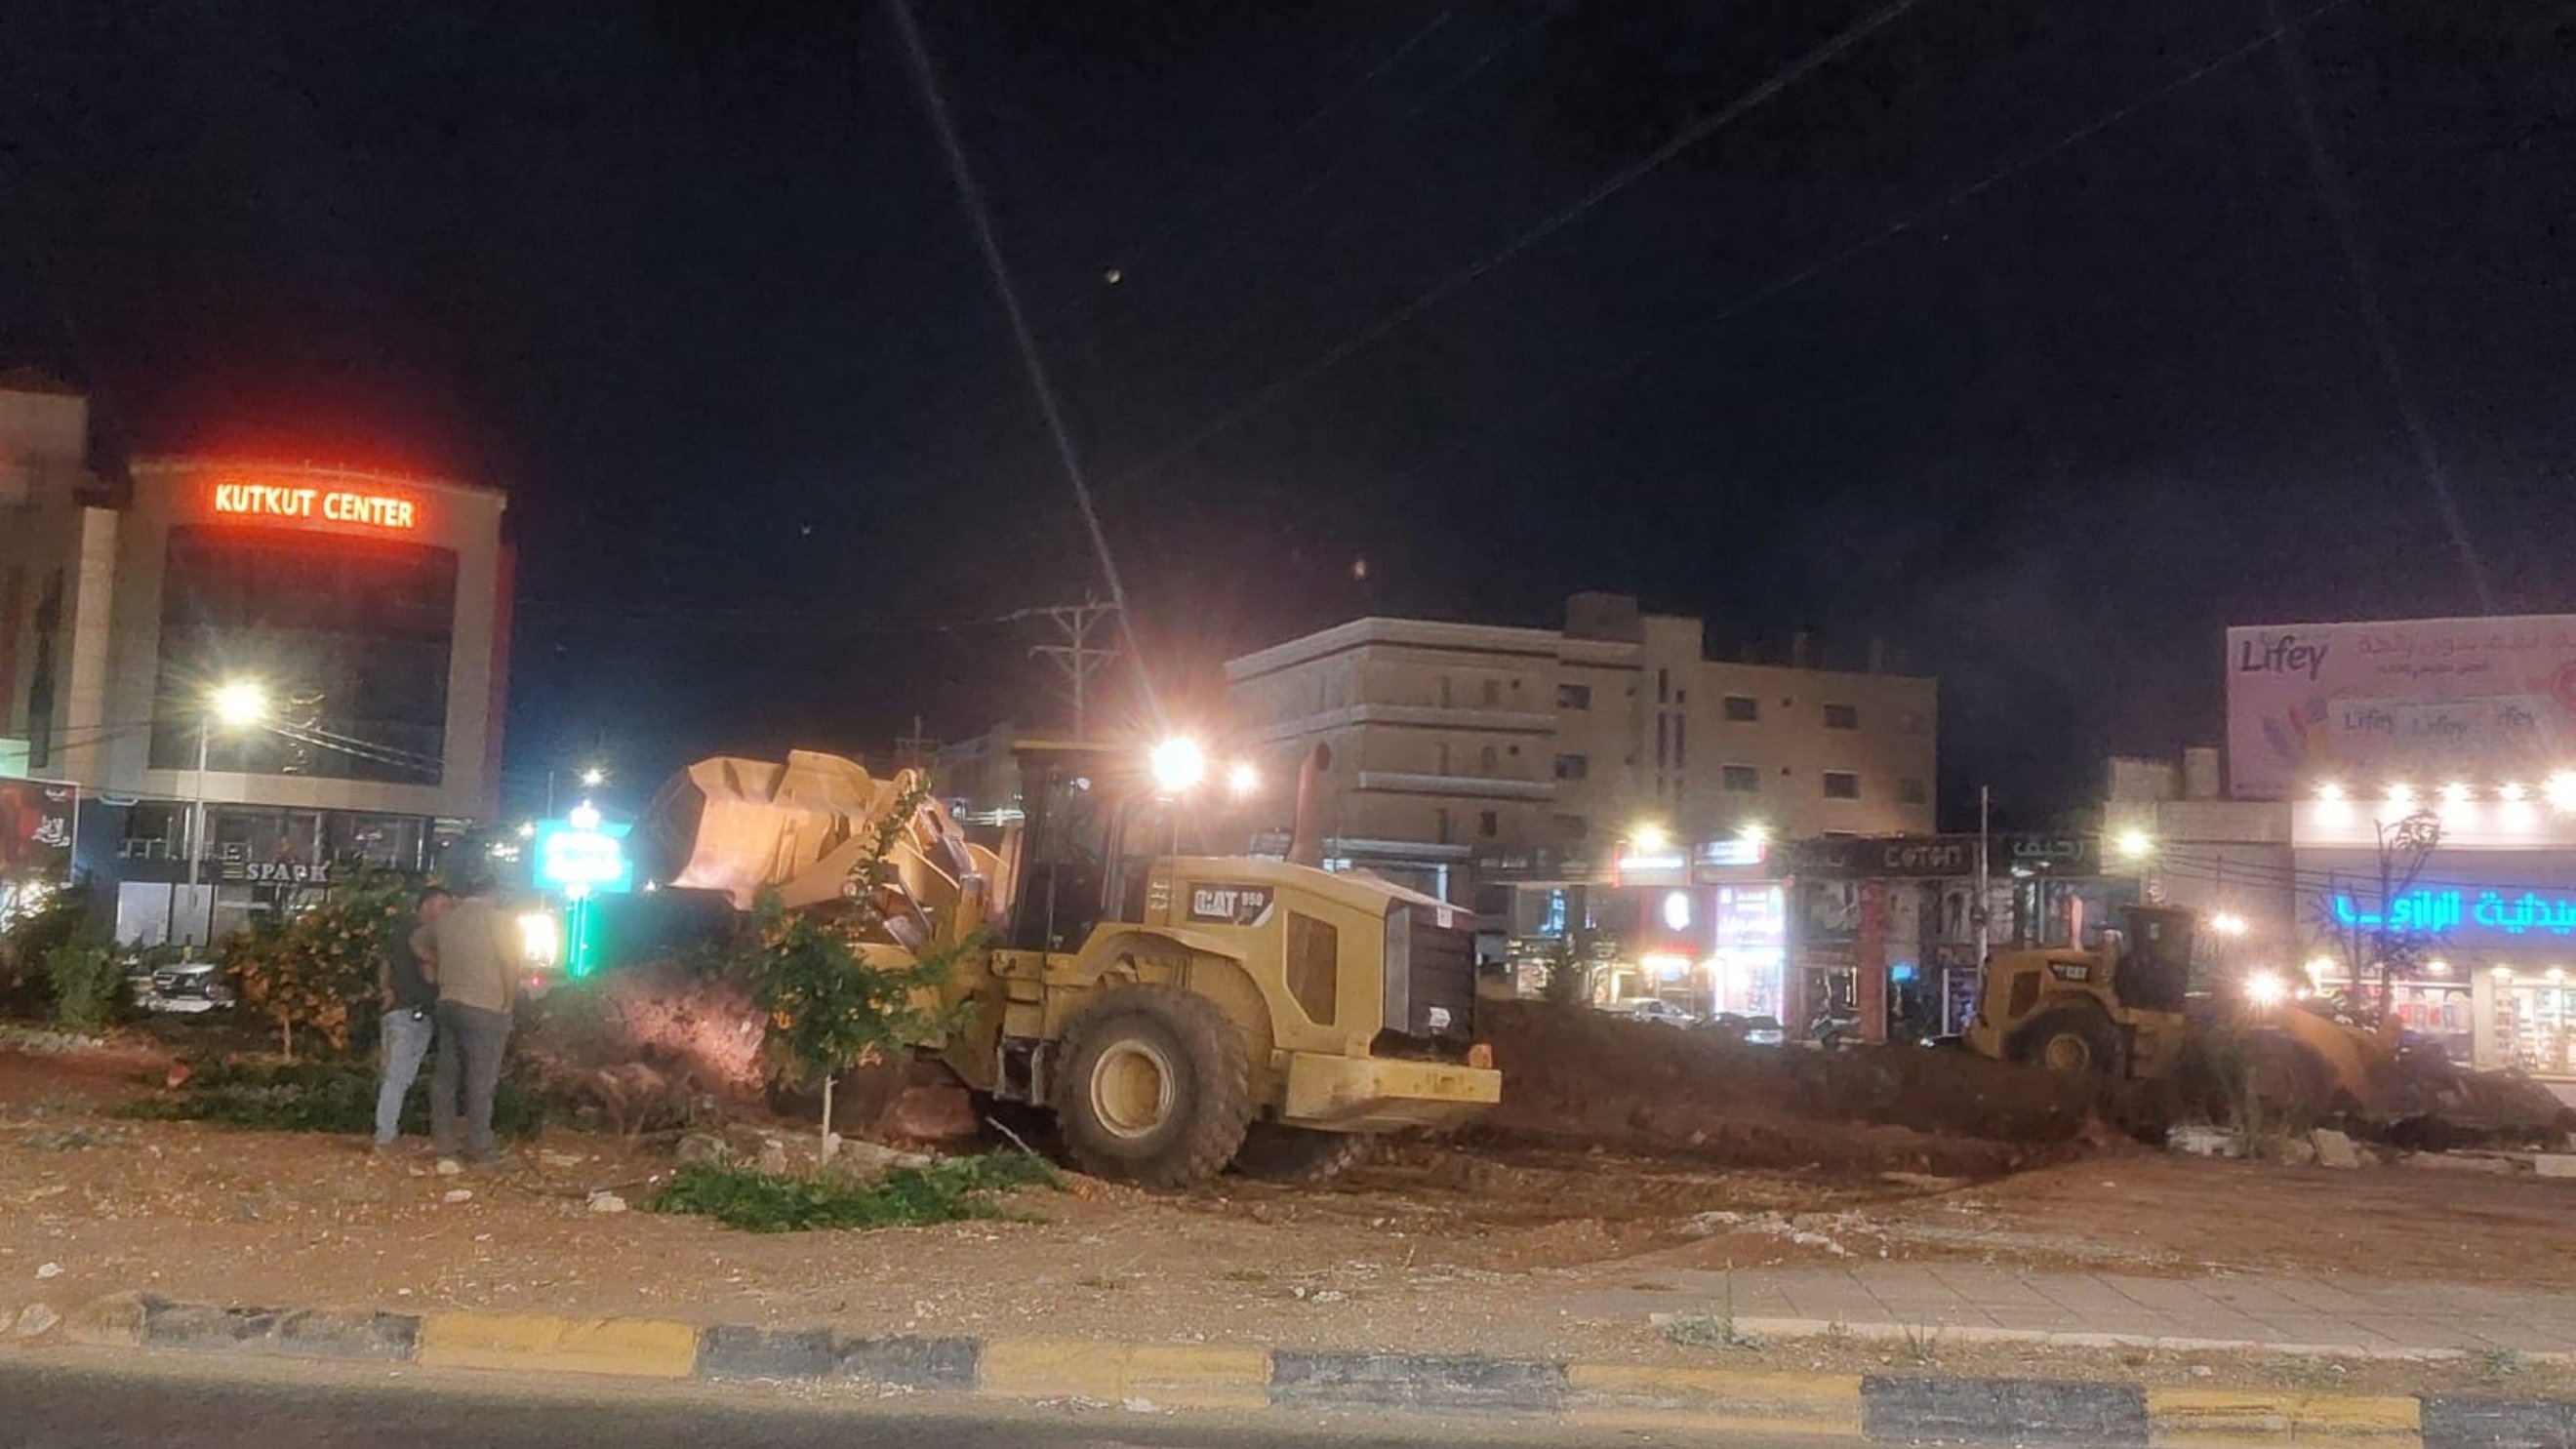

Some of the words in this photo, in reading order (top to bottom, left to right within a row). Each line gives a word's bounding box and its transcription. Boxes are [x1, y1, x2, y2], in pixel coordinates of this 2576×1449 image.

[215, 483, 318, 516] KUTKUT
[323, 492, 414, 528] CENTER
[2239, 634, 2329, 680] Lifey
[246, 859, 331, 882] SPARK
[1193, 889, 1238, 917] CAT
[2474, 891, 2576, 934] يدلية
